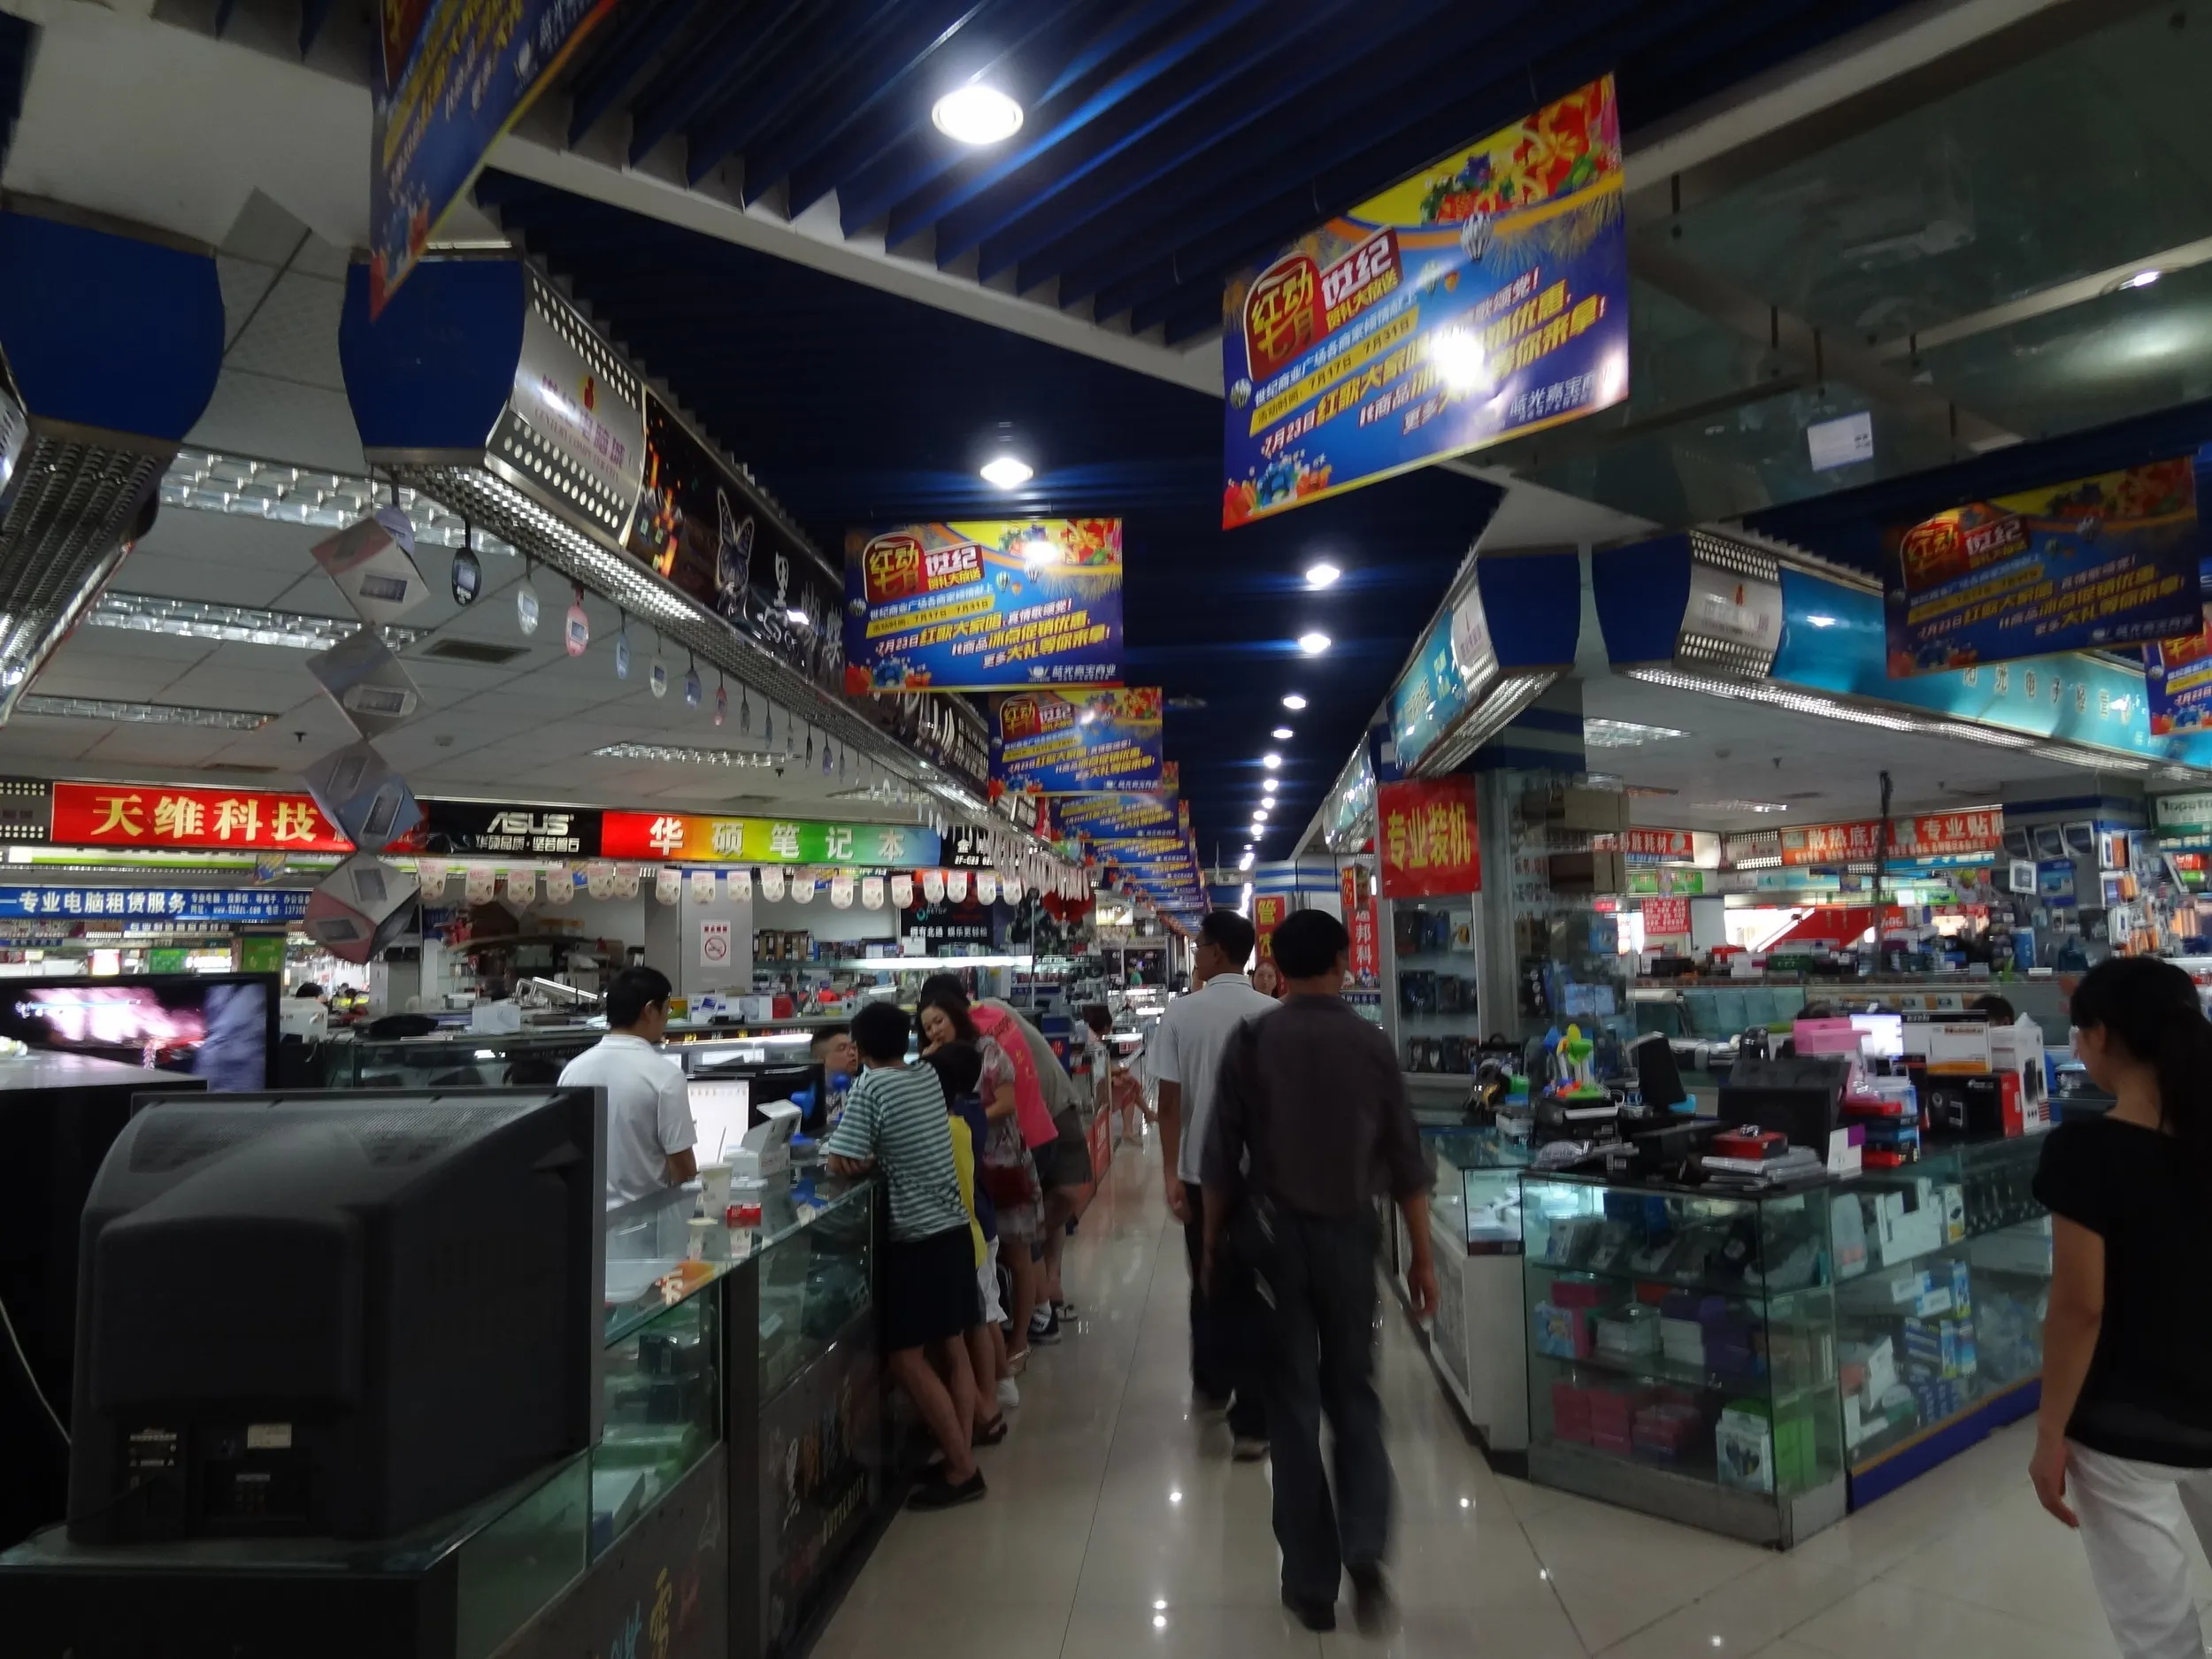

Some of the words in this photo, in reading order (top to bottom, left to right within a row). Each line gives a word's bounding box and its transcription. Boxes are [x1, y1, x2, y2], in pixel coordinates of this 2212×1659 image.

[1322, 234, 1393, 309] 世纪
[926, 547, 978, 577] 世纪
[91, 794, 318, 842] 天维科技
[488, 811, 570, 836] ASUS
[649, 817, 904, 862] 华硕笔记本
[1388, 802, 1471, 872] 专业装机
[19, 890, 186, 913] 专业电脑租赁服务
